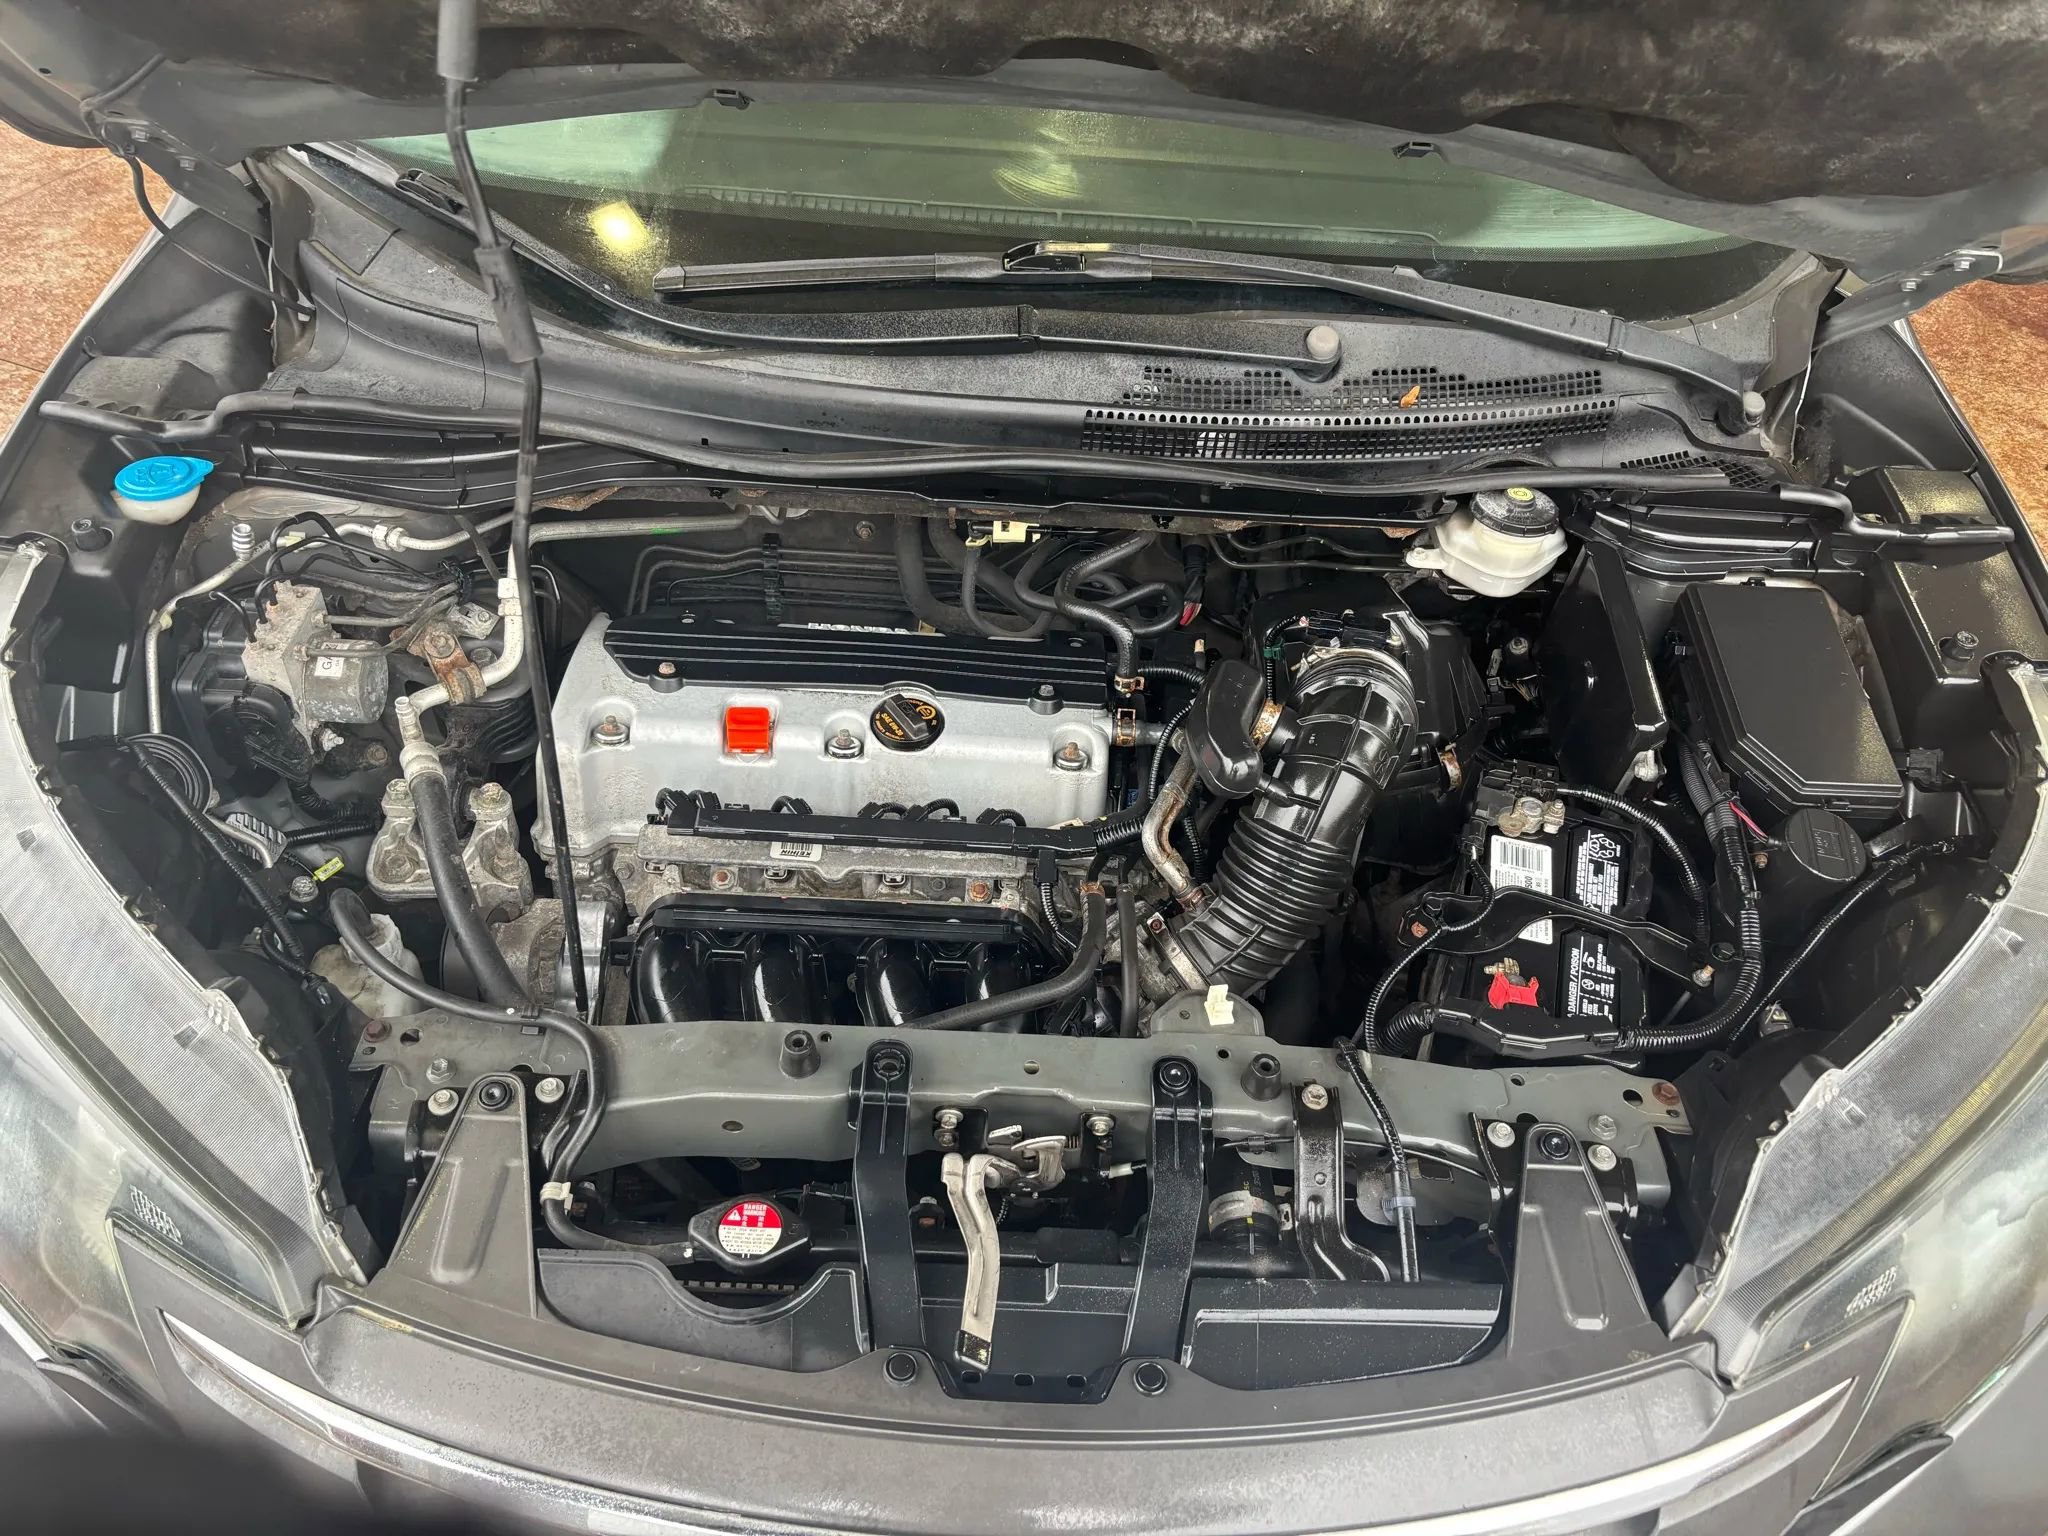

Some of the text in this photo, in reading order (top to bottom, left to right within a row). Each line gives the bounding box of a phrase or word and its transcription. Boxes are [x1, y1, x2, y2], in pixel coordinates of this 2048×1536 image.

[807, 622, 912, 635] HONDA
[881, 712, 893, 723] SAE
[779, 849, 812, 858] KEIHIN
[1525, 876, 1533, 889] 500
[1568, 947, 1580, 1013] DANGER / POISON
